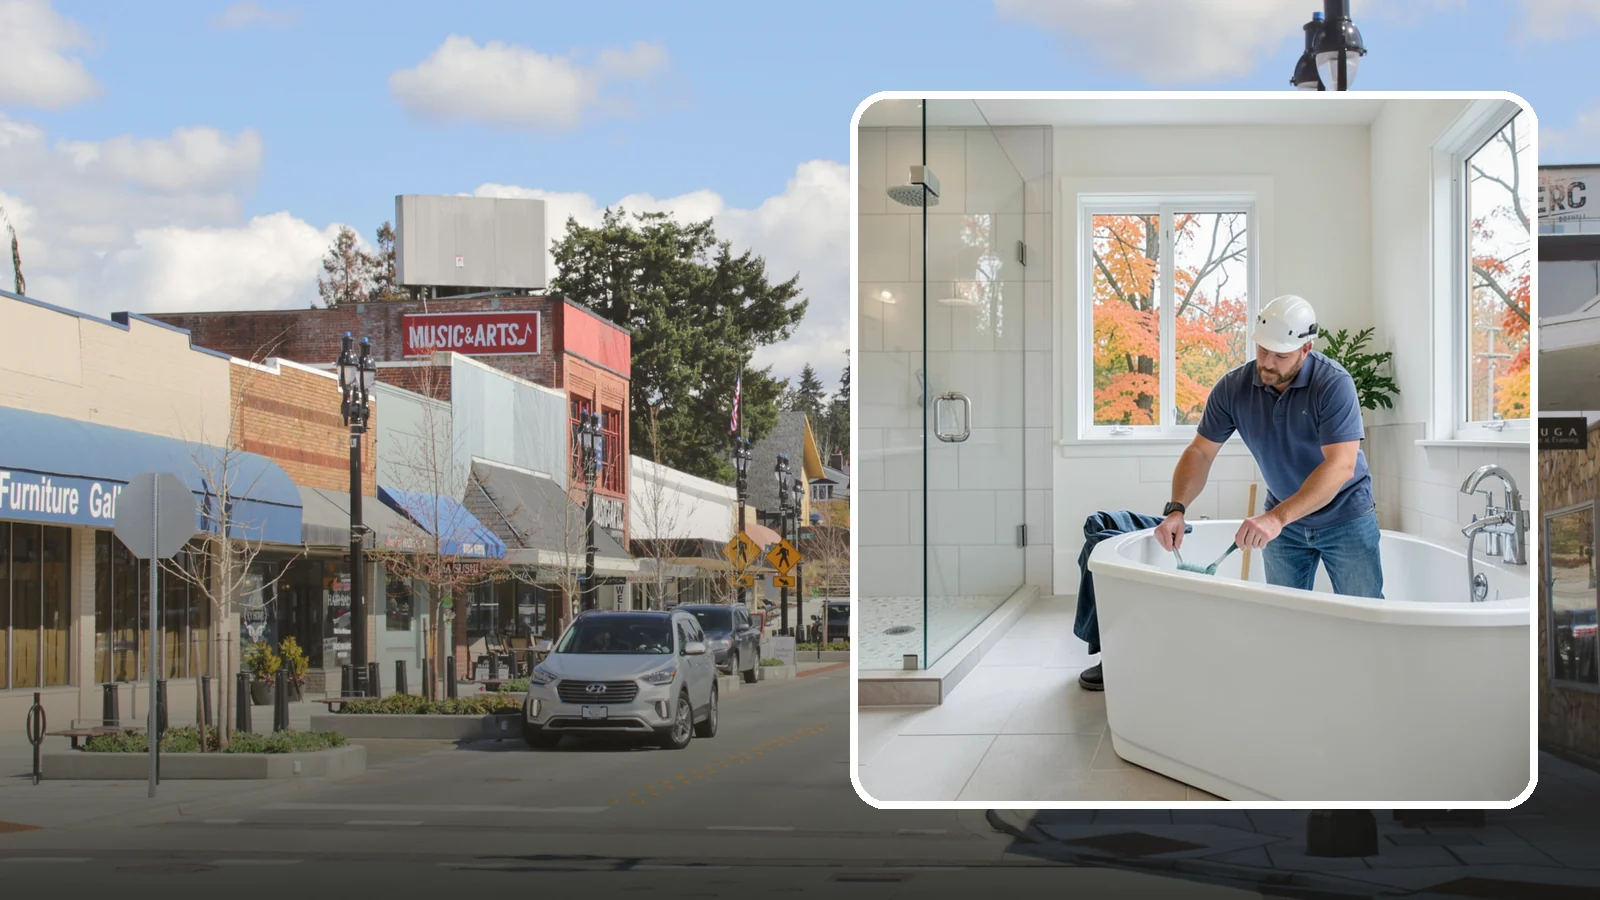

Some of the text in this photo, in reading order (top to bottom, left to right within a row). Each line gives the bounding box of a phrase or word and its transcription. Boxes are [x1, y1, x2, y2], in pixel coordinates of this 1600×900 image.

[408, 323, 520, 349] MUSIC&ARTS
[0, 472, 122, 519] Furniture Gal
